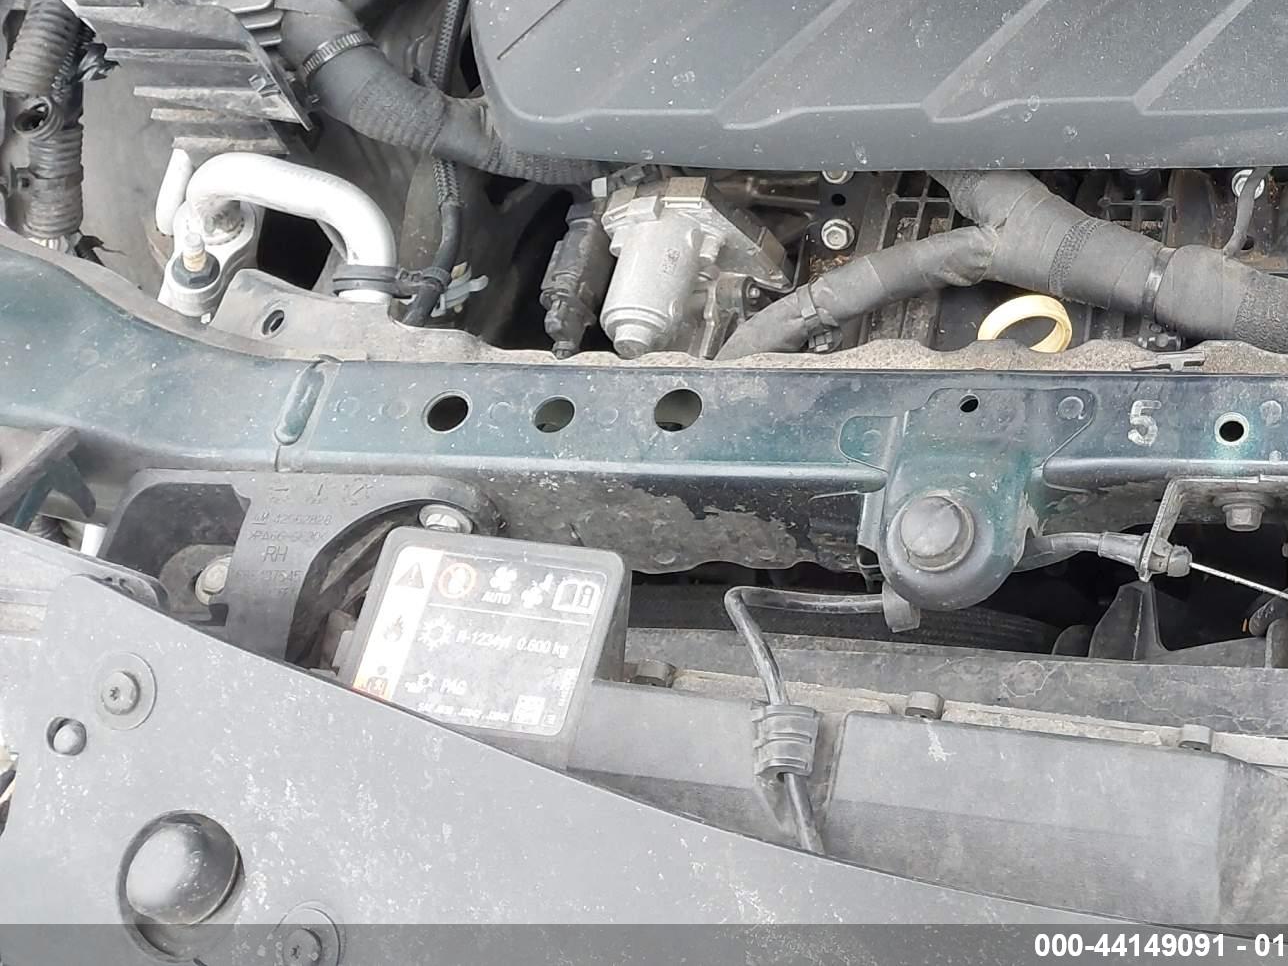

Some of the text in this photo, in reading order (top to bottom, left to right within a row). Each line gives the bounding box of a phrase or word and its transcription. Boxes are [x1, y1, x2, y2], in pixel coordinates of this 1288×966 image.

[1128, 400, 1162, 447] 5
[263, 545, 289, 562] RH
[480, 591, 512, 604] AUTO
